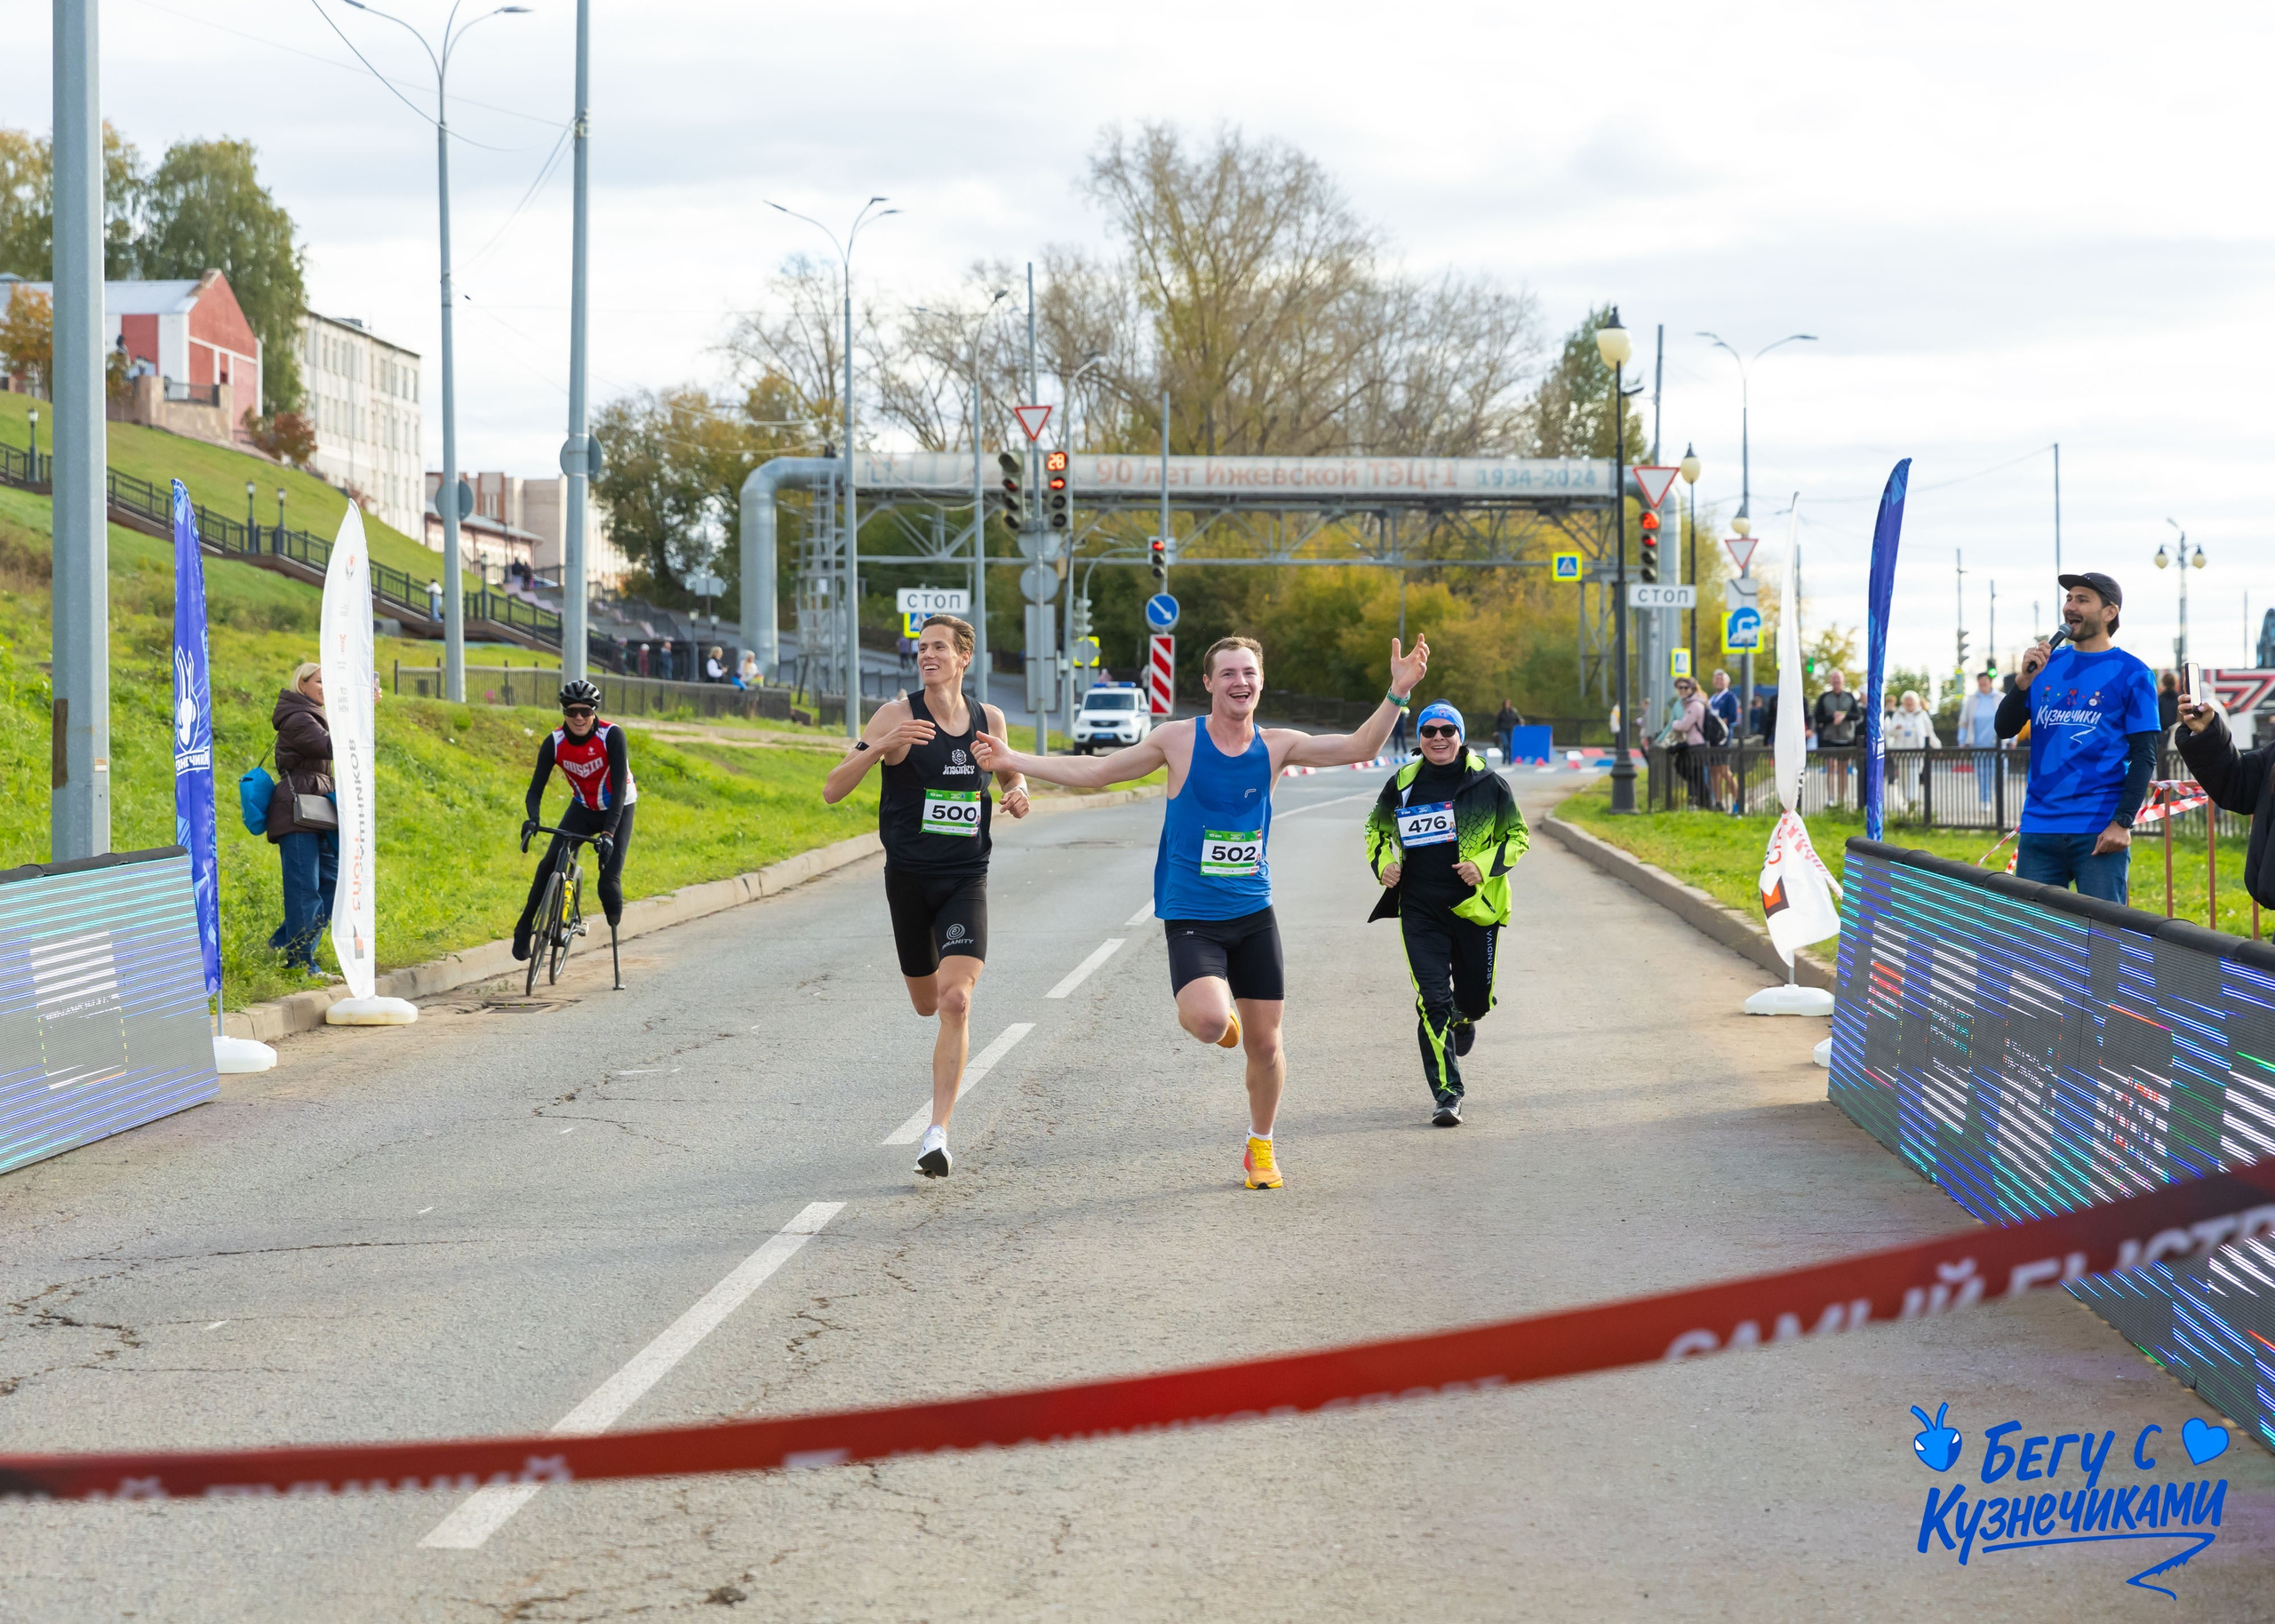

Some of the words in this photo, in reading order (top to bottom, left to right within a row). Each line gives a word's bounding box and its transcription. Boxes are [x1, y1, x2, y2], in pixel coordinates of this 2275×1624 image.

[1047, 452, 1066, 471] 28
[1097, 458, 1132, 485] 90
[1143, 466, 1193, 485] лет
[1206, 458, 1358, 487] Ижевской
[1367, 460, 1457, 491] ТЭЦ-1
[1478, 468, 1596, 488] 1934-2024
[907, 593, 961, 609] СТОП
[1638, 588, 1688, 603] СТОП
[2035, 705, 2103, 729] Кузнечики
[563, 757, 604, 778] RUSSIA
[931, 804, 977, 822] 500
[1408, 816, 1447, 833] 476
[1210, 845, 1257, 862] 502
